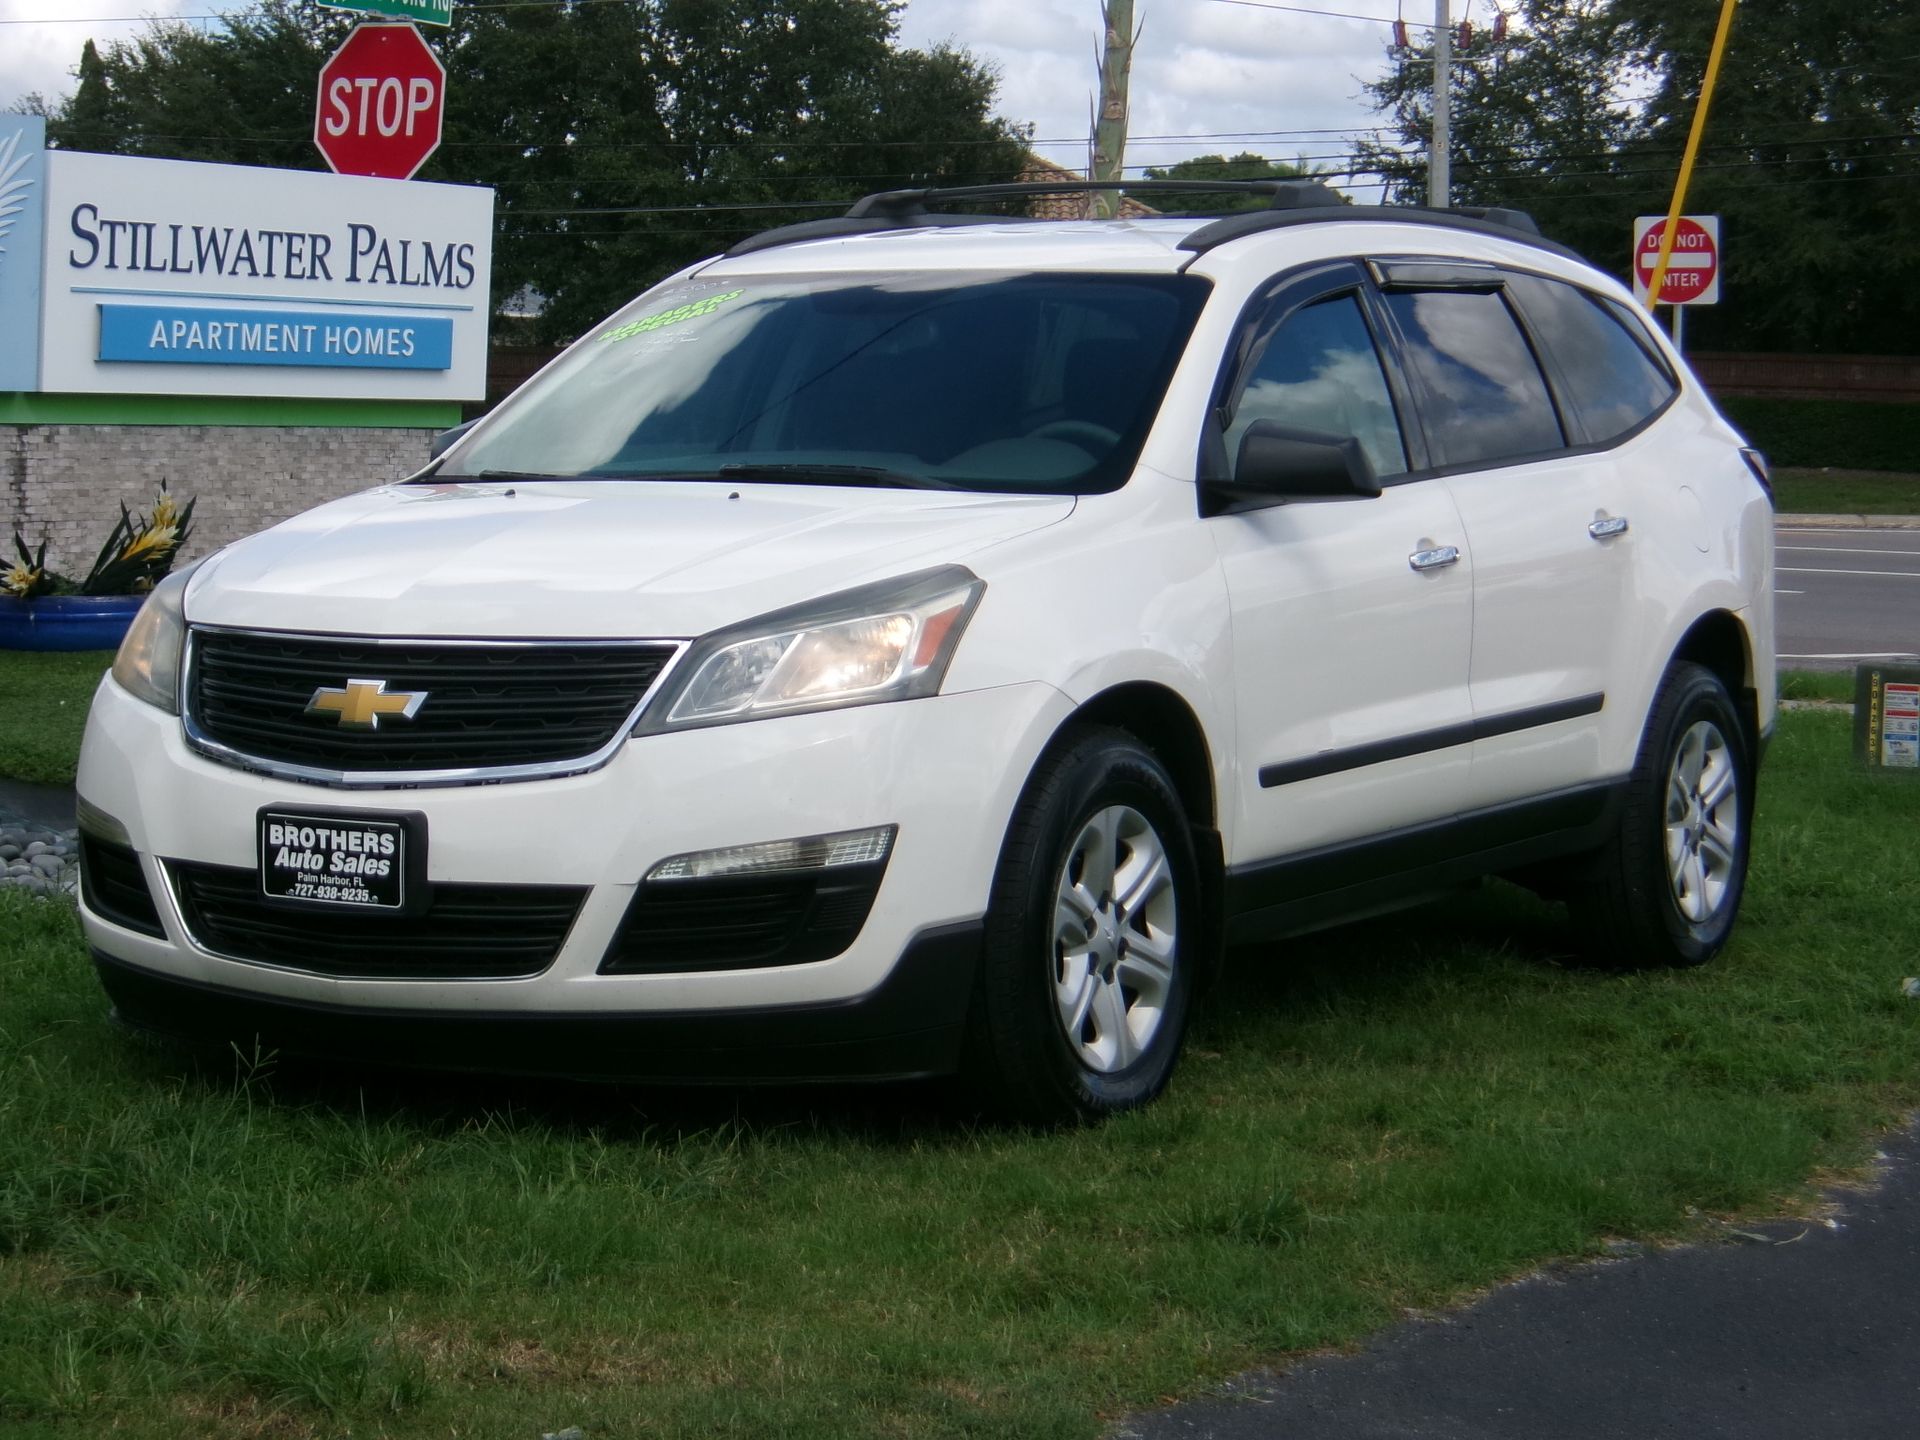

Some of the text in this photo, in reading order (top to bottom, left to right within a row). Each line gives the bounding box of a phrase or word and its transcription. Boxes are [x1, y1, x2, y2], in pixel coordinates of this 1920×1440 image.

[325, 76, 434, 137] STOP
[69, 203, 475, 289] STILLWATER PALMS
[1677, 234, 1705, 247] NOT
[1662, 273, 1699, 287] NTER
[149, 319, 415, 357] APARTMENT HOMES
[613, 303, 719, 343] SPECIAL
[269, 823, 395, 855] BROTHERS
[274, 846, 391, 876] Auto Sales
[295, 884, 369, 901] 727-938-9235
[298, 872, 365, 887] Palm Harbor, FL
